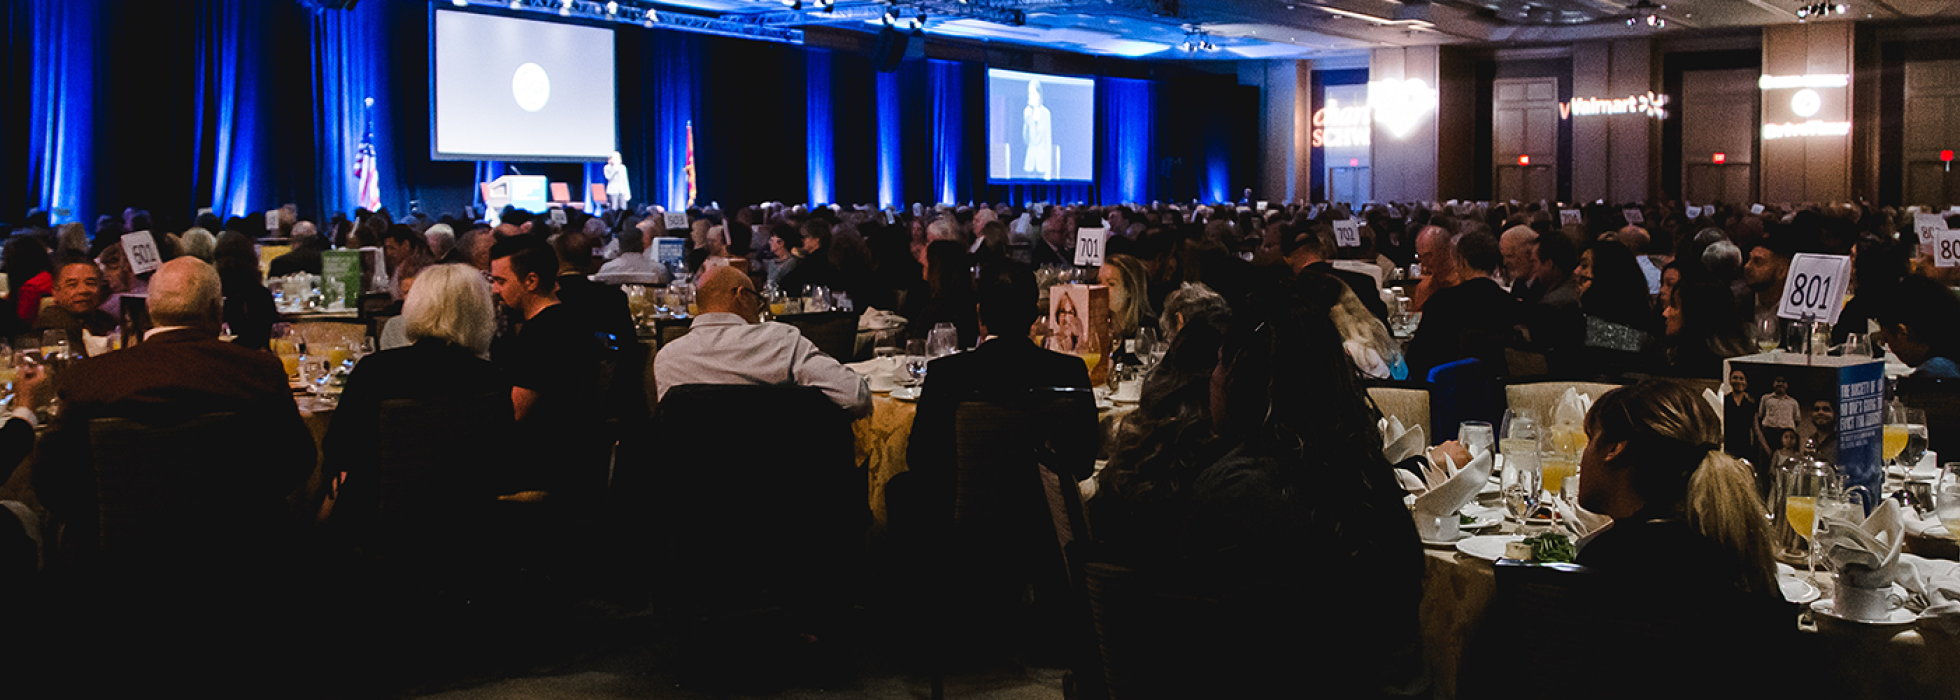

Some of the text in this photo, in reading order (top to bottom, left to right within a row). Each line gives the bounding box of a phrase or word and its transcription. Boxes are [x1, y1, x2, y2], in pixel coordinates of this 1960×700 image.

[1559, 94, 1638, 119] Walmart
[1337, 227, 1356, 241] 702
[132, 243, 156, 265] 601
[1080, 237, 1099, 258] 701
[1790, 272, 1831, 309] 801
